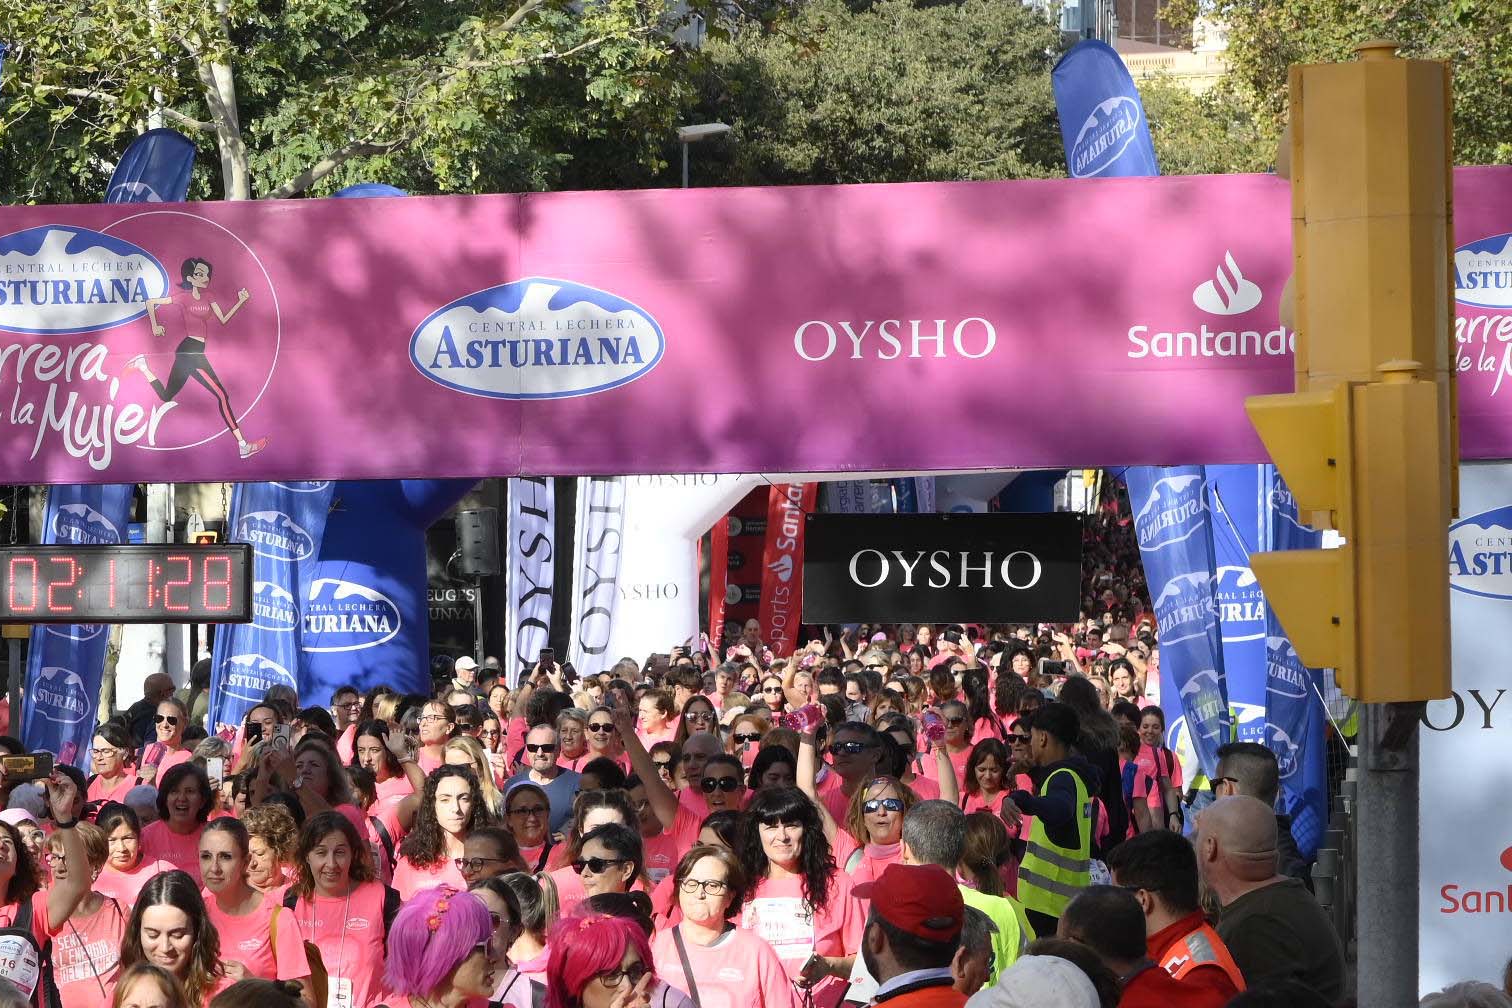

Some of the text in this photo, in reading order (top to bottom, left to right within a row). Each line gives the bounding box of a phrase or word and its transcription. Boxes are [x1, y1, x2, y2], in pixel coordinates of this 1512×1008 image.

[72, 260, 144, 273] LECHERA
[468, 318, 637, 333] CENTRAL LECHERA
[794, 317, 997, 362] OYSHO
[429, 324, 645, 370] ASTURIANA
[1128, 325, 1295, 359] Santand
[1478, 343, 1496, 372] la
[11, 383, 35, 425] la
[30, 378, 179, 471] Mujer
[849, 548, 1043, 590] OYSHO
[619, 582, 679, 601] YSHO
[338, 603, 387, 612] LECHERA
